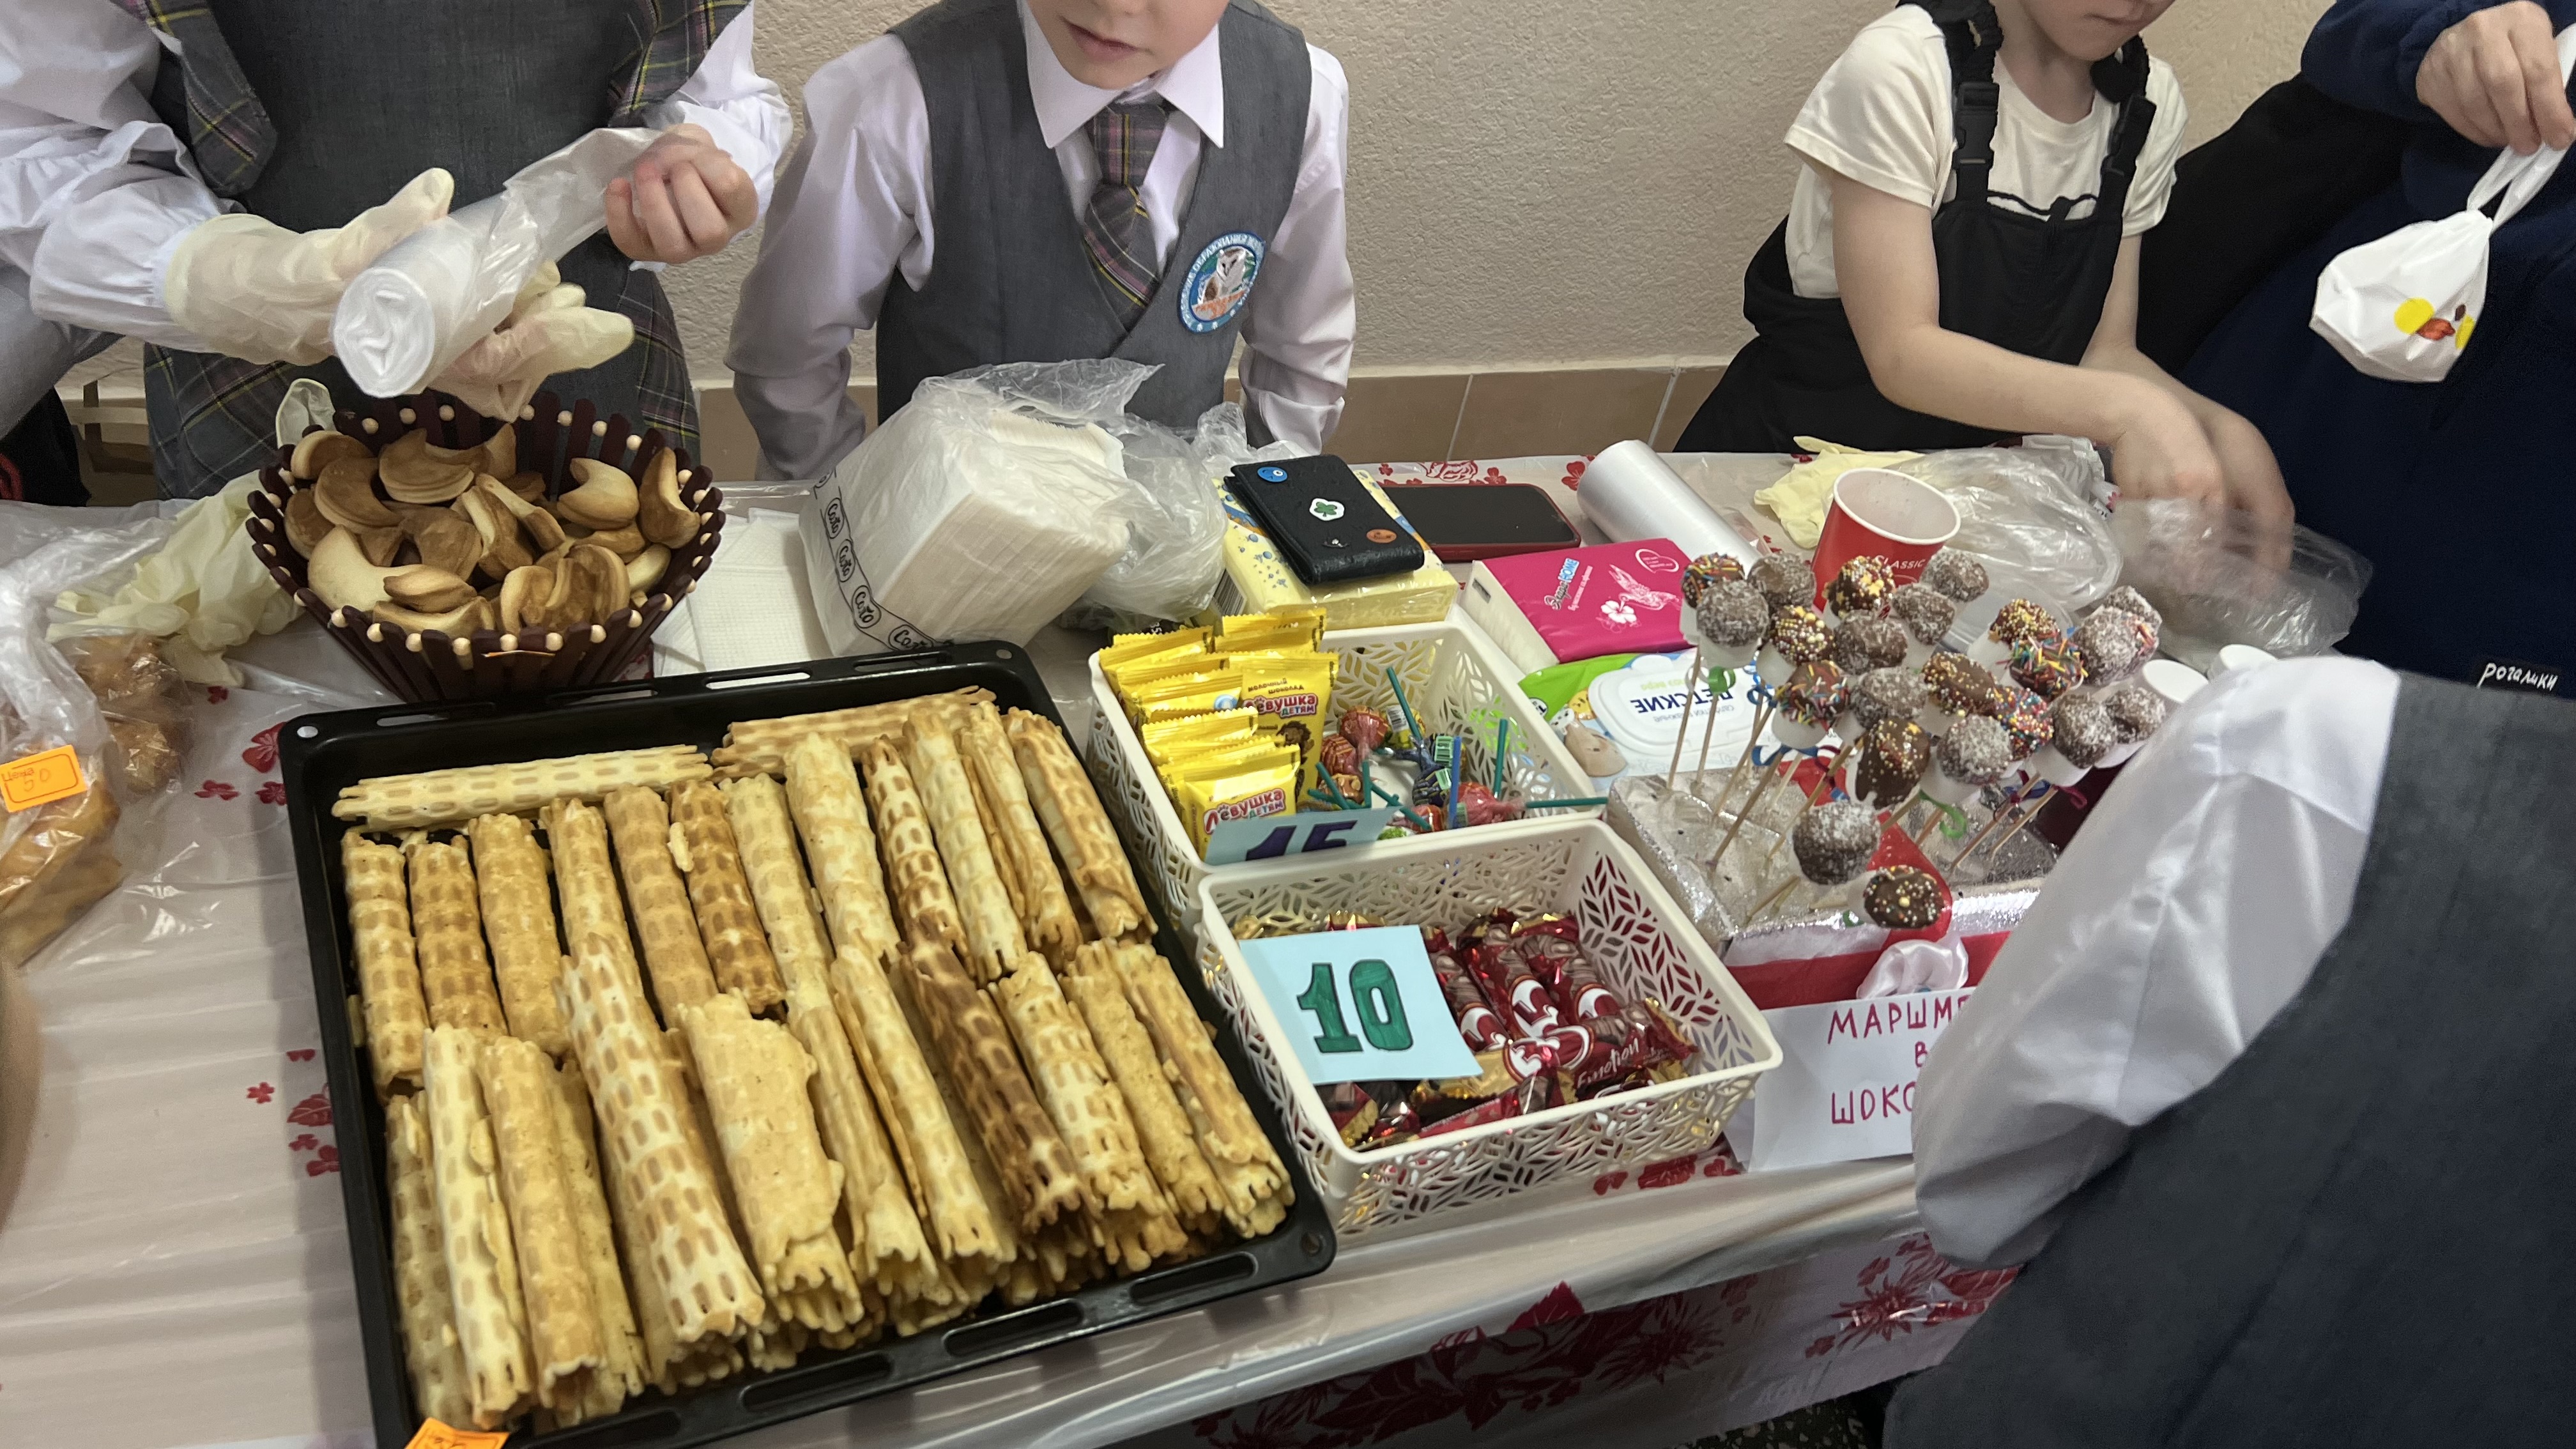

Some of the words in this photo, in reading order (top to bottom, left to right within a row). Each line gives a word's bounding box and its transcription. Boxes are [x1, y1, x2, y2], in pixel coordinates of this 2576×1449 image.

[1282, 705, 1315, 716] ДЕТЯМ
[1206, 789, 1284, 833] Лёвушка
[1250, 802, 1284, 820] ДЕТЯМ
[1296, 958, 1414, 1054] 10
[1578, 1038, 1639, 1087] Emotion
